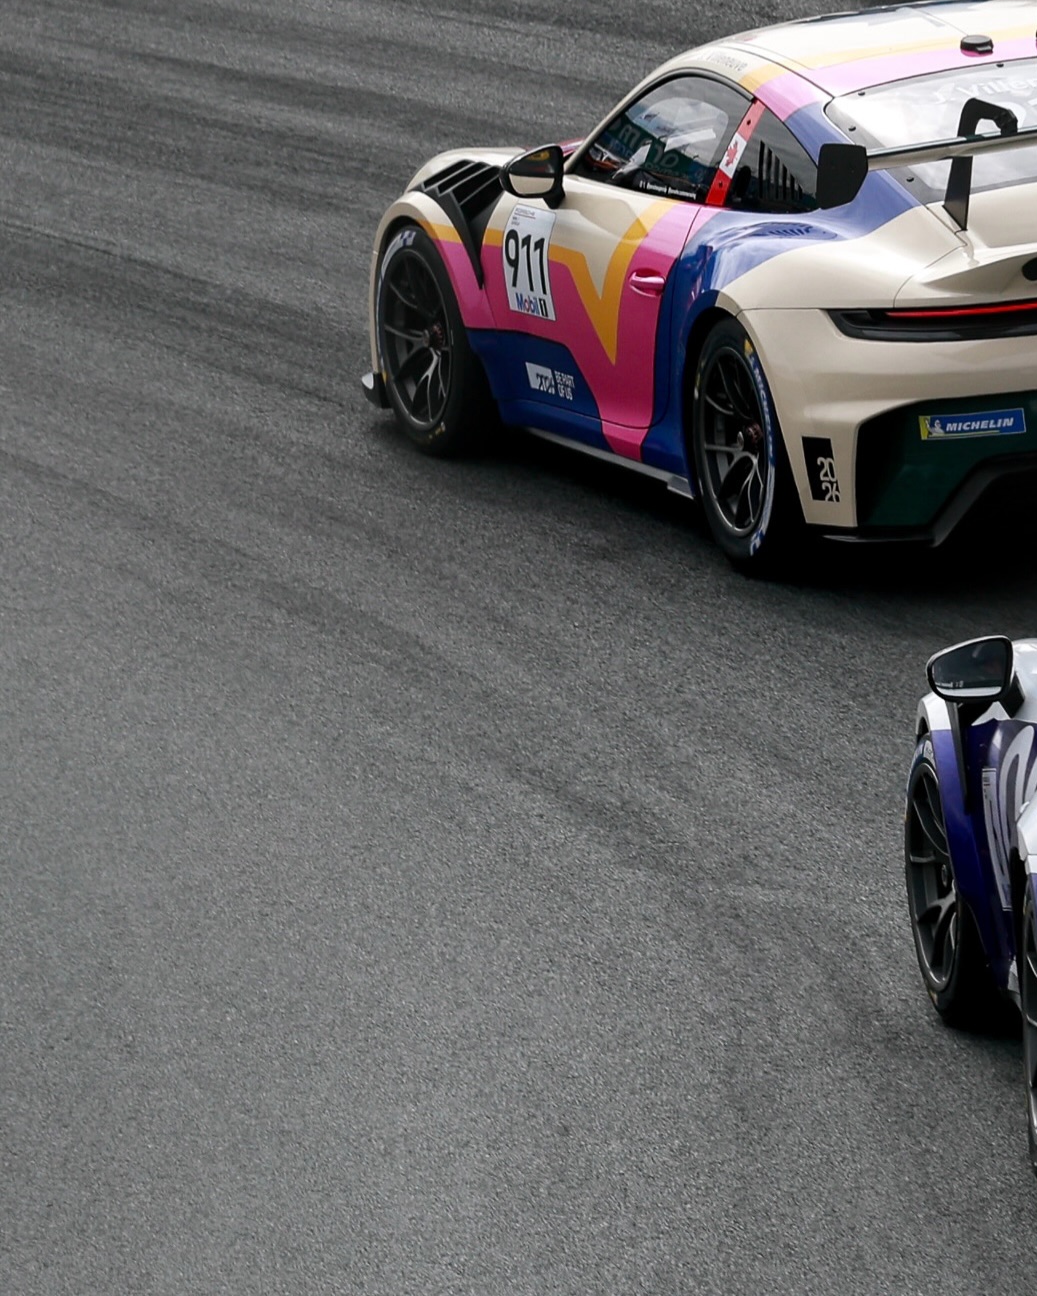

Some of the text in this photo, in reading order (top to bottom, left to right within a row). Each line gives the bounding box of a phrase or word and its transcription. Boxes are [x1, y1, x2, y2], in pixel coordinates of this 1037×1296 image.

[504, 228, 547, 296] 911
[515, 292, 541, 316] Mobil
[945, 415, 1015, 433] MICHELIN
[817, 457, 836, 482] 20
[822, 482, 840, 502] 26
